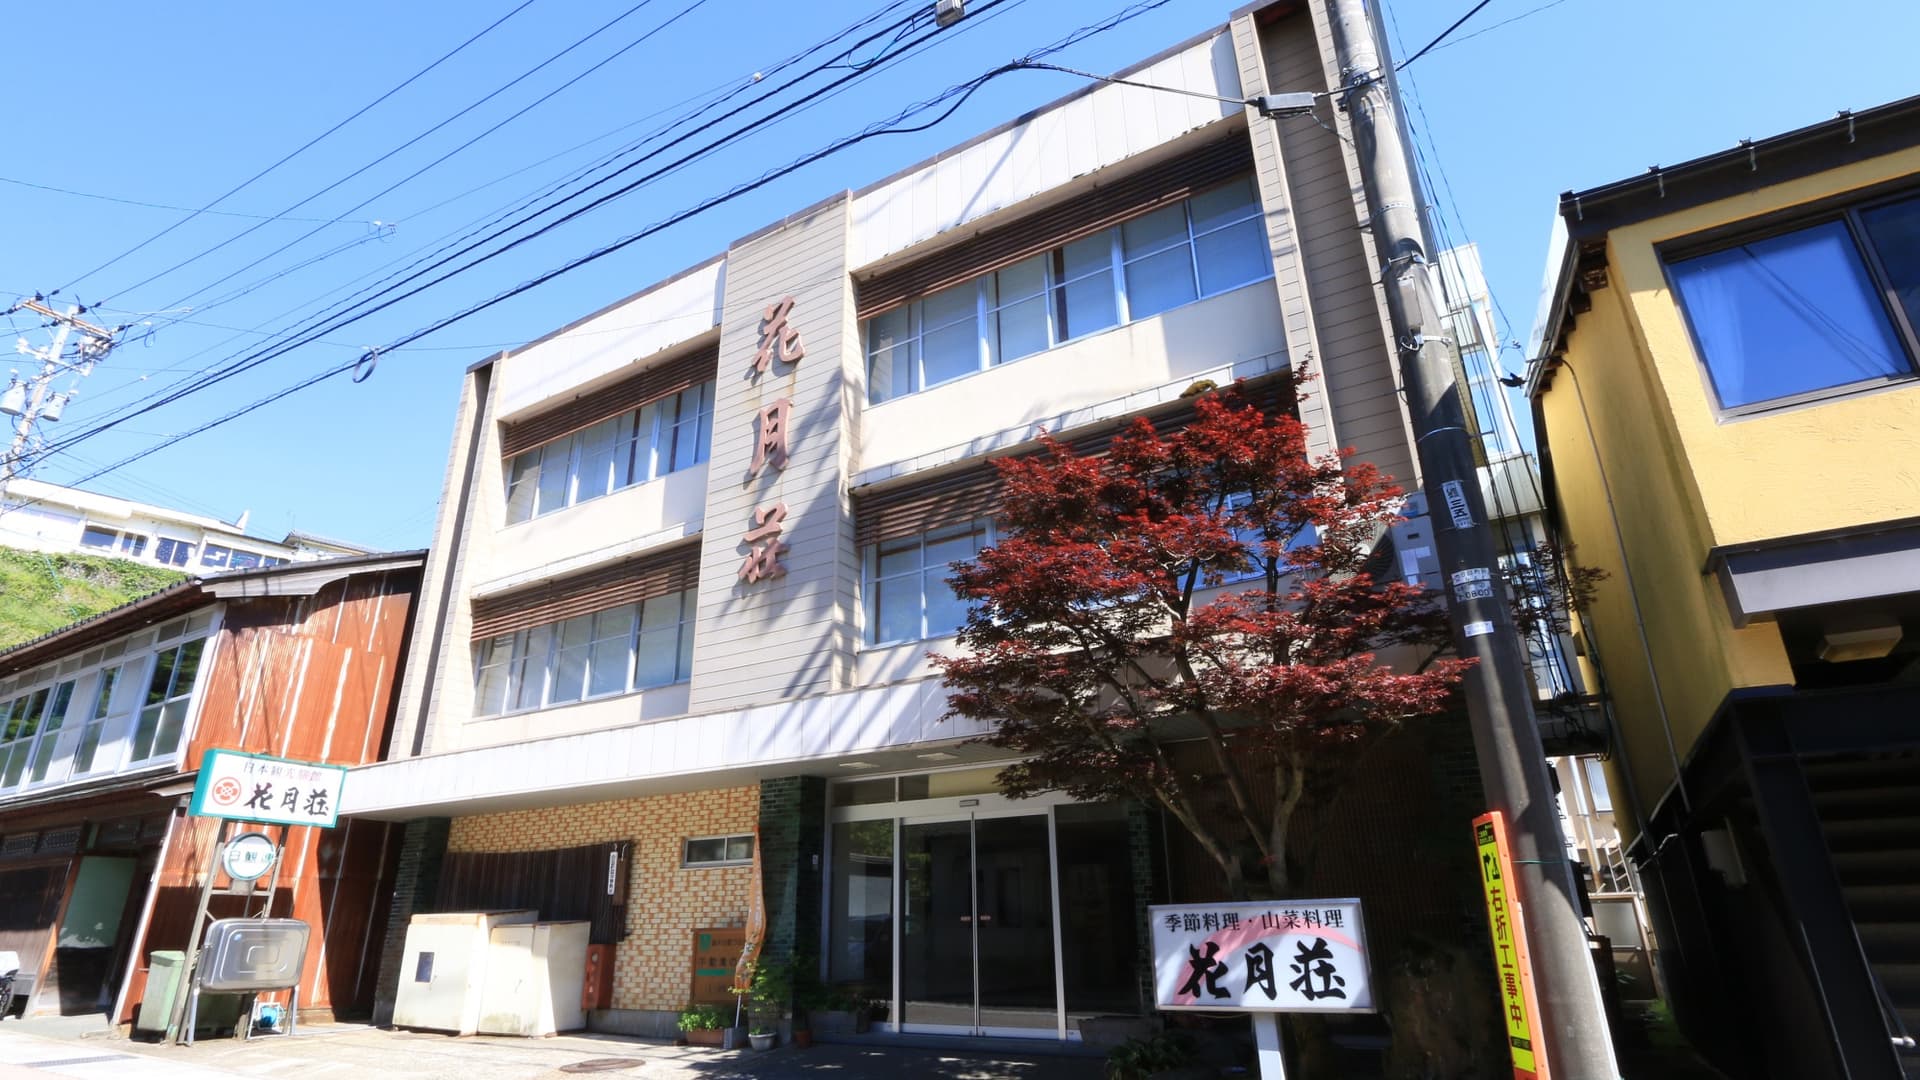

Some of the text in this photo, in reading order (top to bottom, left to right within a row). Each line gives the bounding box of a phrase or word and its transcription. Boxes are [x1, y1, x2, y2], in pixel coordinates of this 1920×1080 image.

[738, 295, 806, 584] 花月荘
[244, 782, 330, 816] 花月荘
[1164, 909, 1345, 932] 季節料理・山菜料理
[1178, 937, 1347, 1001] 花月荘
[1490, 886, 1523, 1030] 右折工事中
